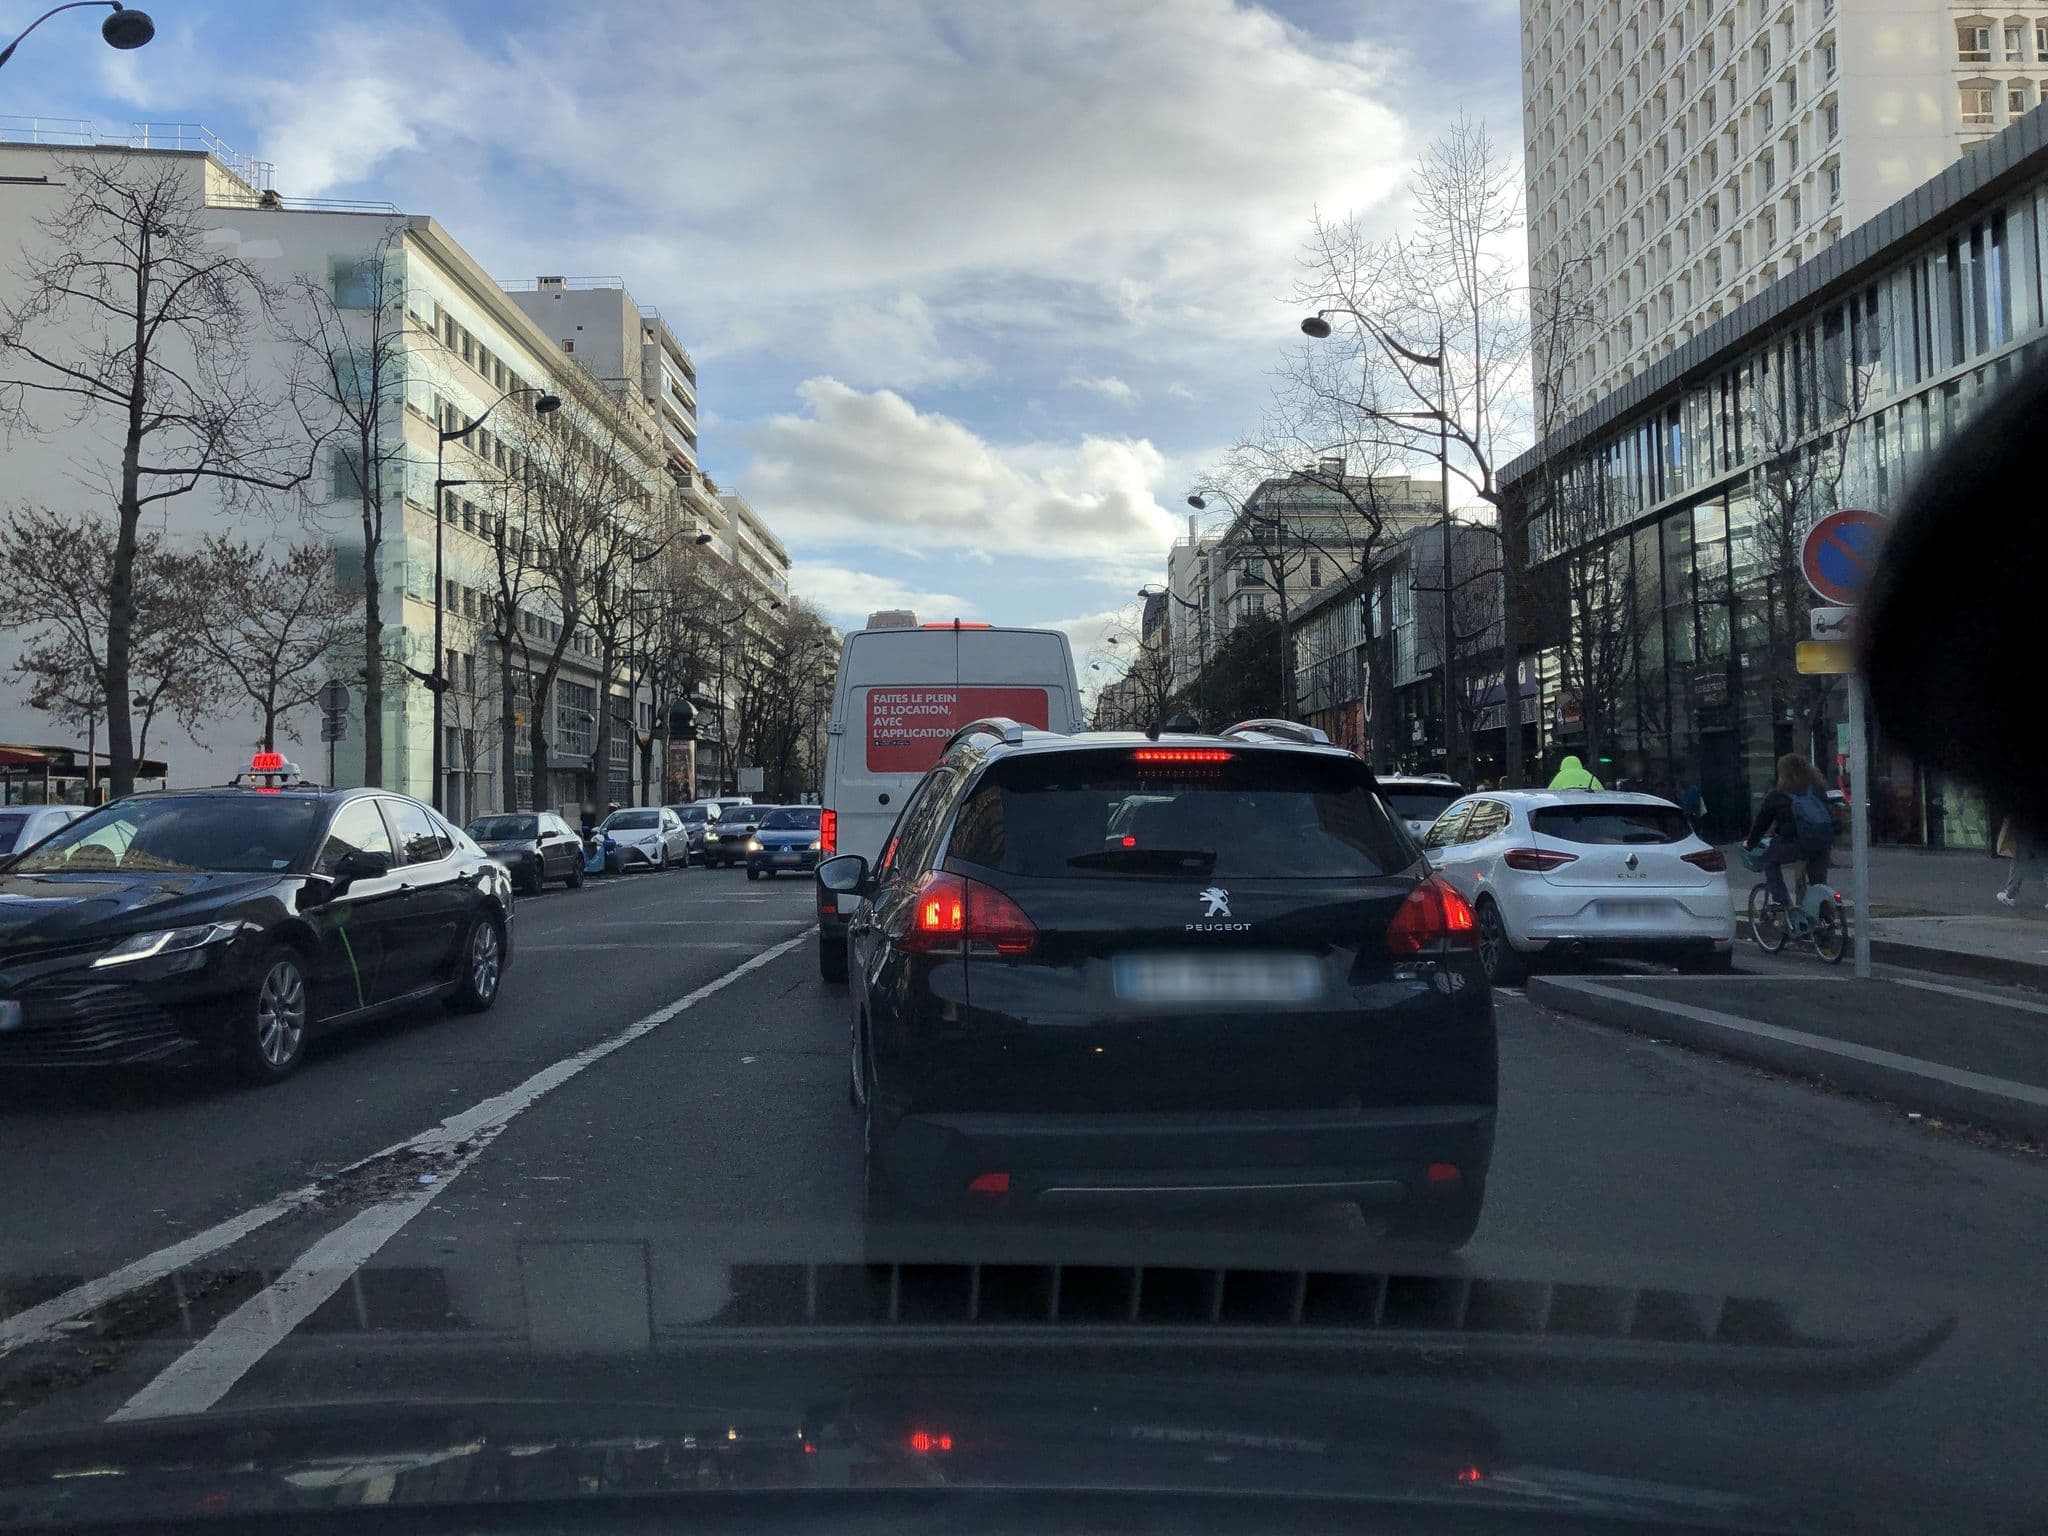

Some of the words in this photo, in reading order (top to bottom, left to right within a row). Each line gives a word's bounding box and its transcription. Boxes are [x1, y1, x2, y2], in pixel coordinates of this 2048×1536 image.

[873, 694, 908, 703] FAITES
[912, 694, 923, 703] LE
[926, 694, 957, 703] PLEIN
[873, 706, 887, 715] DE
[891, 706, 952, 716] LOCATION,
[873, 717, 902, 726] AVEC
[255, 756, 280, 767] TAXI
[1185, 923, 1252, 932] PEUGEOT
